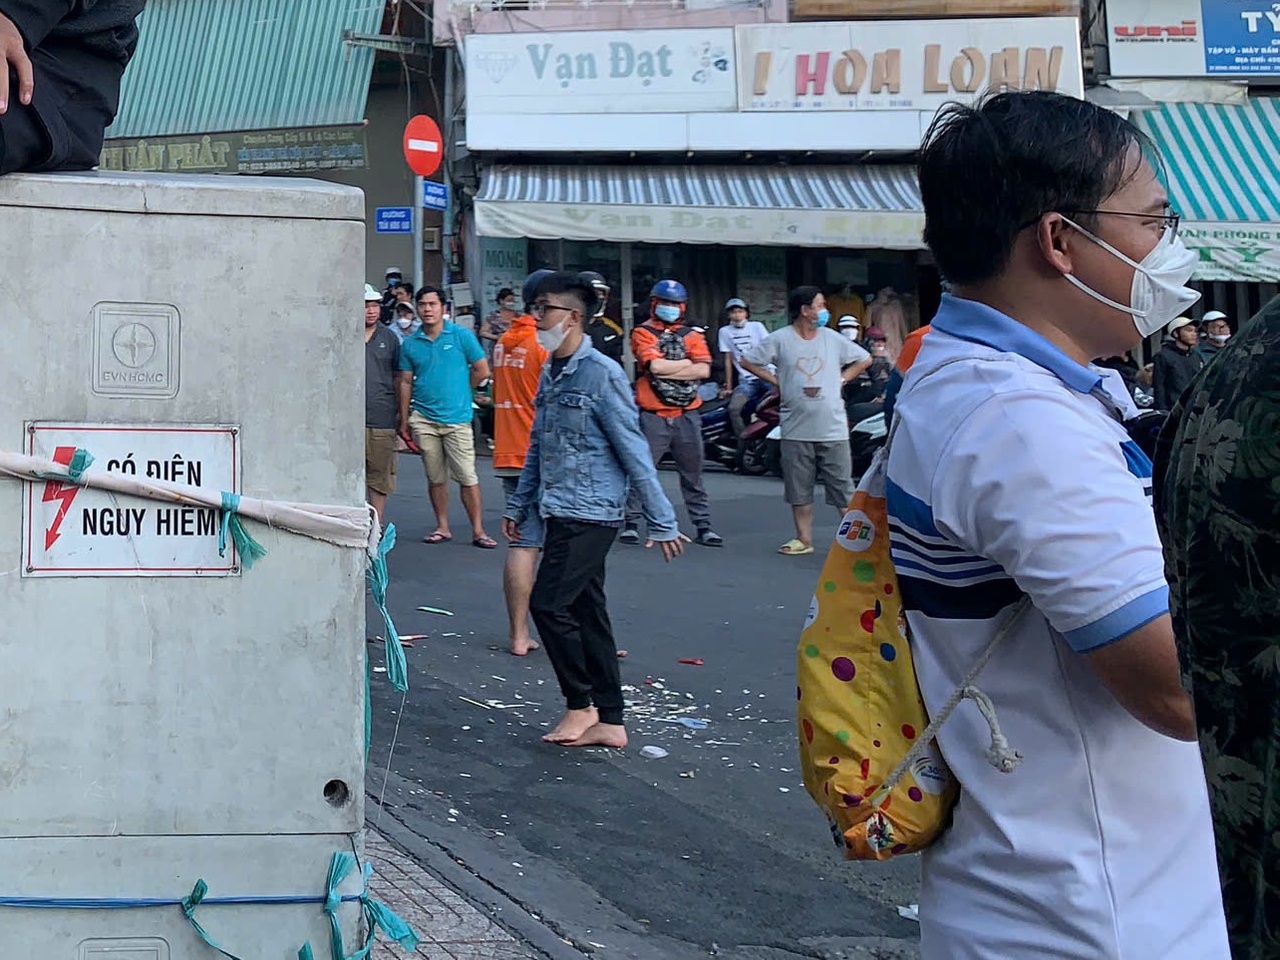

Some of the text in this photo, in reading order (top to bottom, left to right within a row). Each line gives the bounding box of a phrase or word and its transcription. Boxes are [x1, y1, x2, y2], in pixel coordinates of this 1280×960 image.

[1114, 21, 1197, 36] uni
[526, 42, 674, 88] Vạn Đạt
[795, 48, 901, 96] HOA
[923, 44, 1064, 95] LOAN
[82, 508, 146, 536] NGUY
